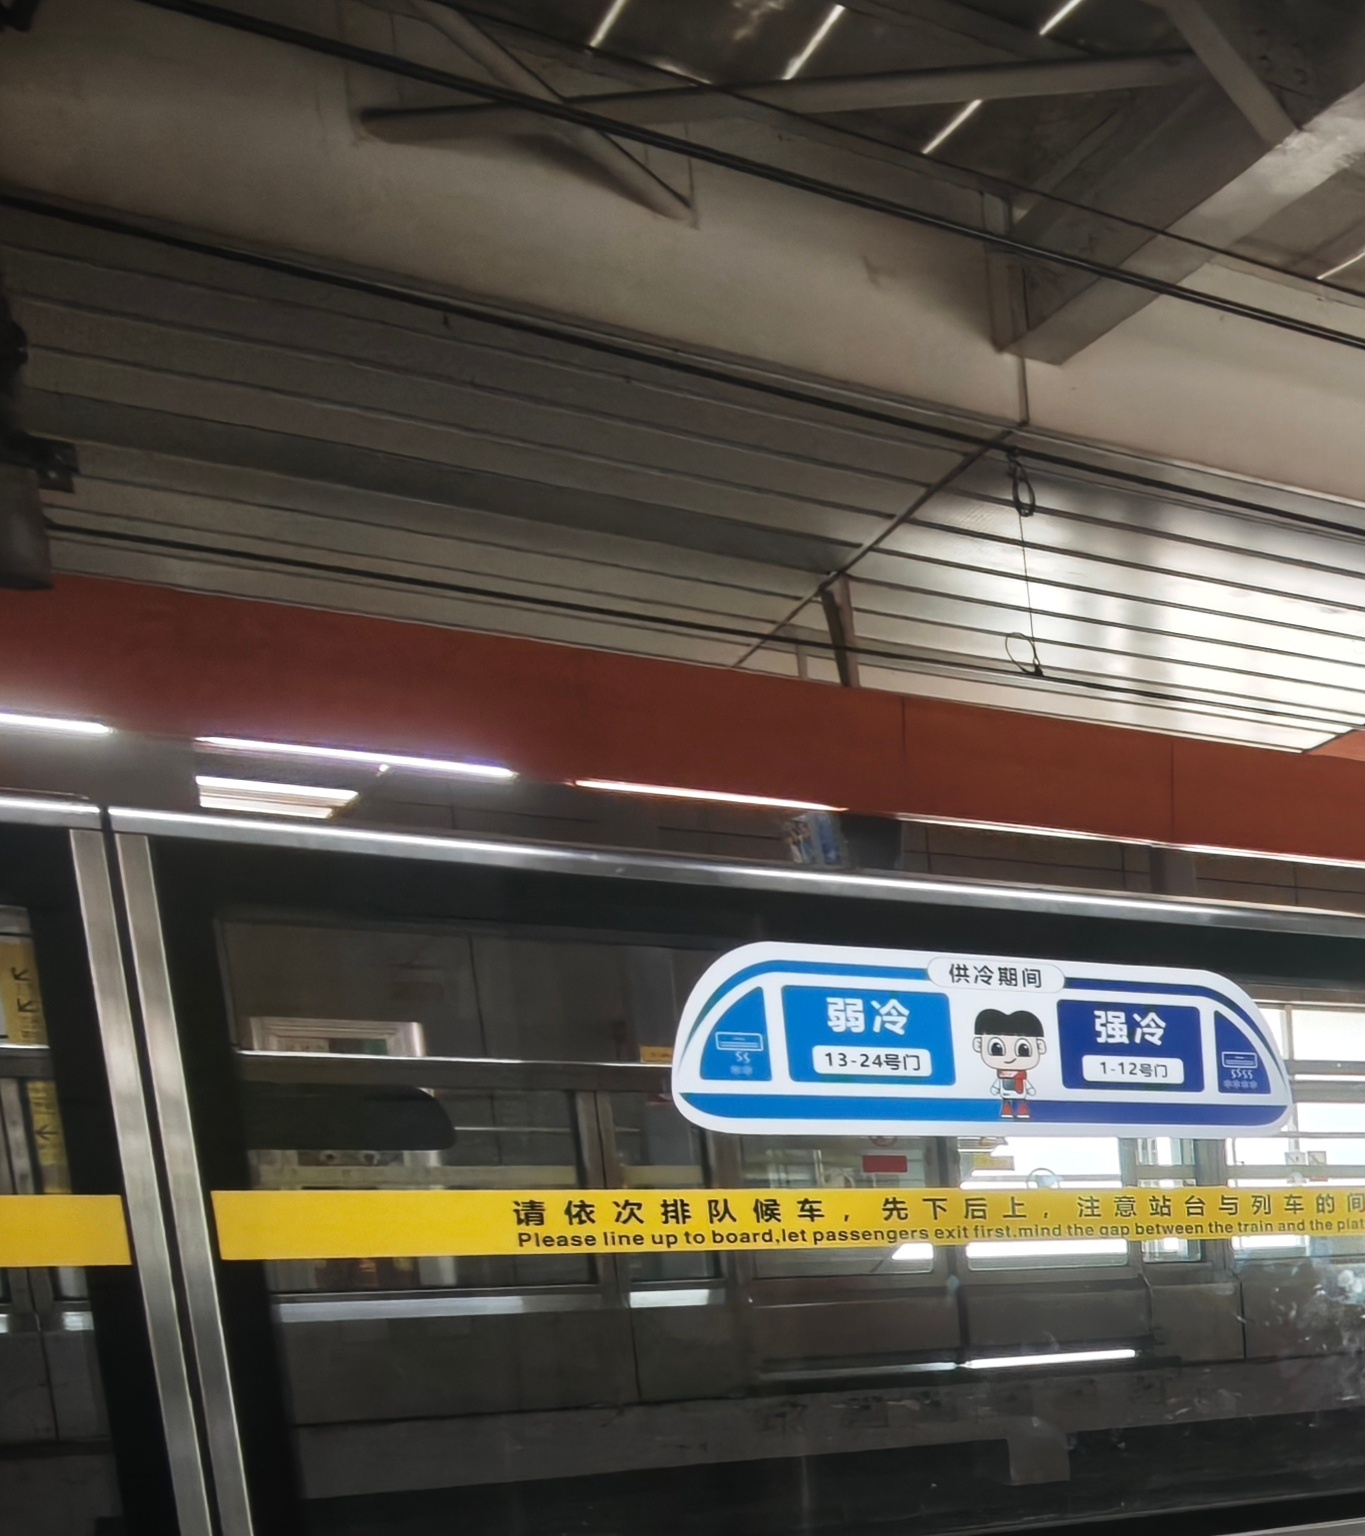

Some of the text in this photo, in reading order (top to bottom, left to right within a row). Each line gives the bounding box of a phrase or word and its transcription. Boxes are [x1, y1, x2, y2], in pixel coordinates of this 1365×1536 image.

[949, 963, 1042, 988] 供冷期间
[826, 996, 911, 1036] 弱冷
[1093, 1010, 1167, 1046] 强冷
[825, 1052, 921, 1071] 13-24号门
[1099, 1061, 1168, 1078] 1-12号门
[518, 1232, 596, 1247] Please
[603, 1231, 645, 1246] line
[651, 1232, 678, 1249] up
[684, 1231, 705, 1244] to
[813, 1227, 929, 1245] passengers
[934, 1226, 968, 1240] exit
[1067, 1223, 1095, 1236] the
[1100, 1224, 1130, 1237] gap
[1134, 1223, 1204, 1235] between
[1208, 1222, 1233, 1234] the
[1237, 1220, 1274, 1233] train
[1278, 1219, 1305, 1232] and
[1308, 1218, 1333, 1231] the
